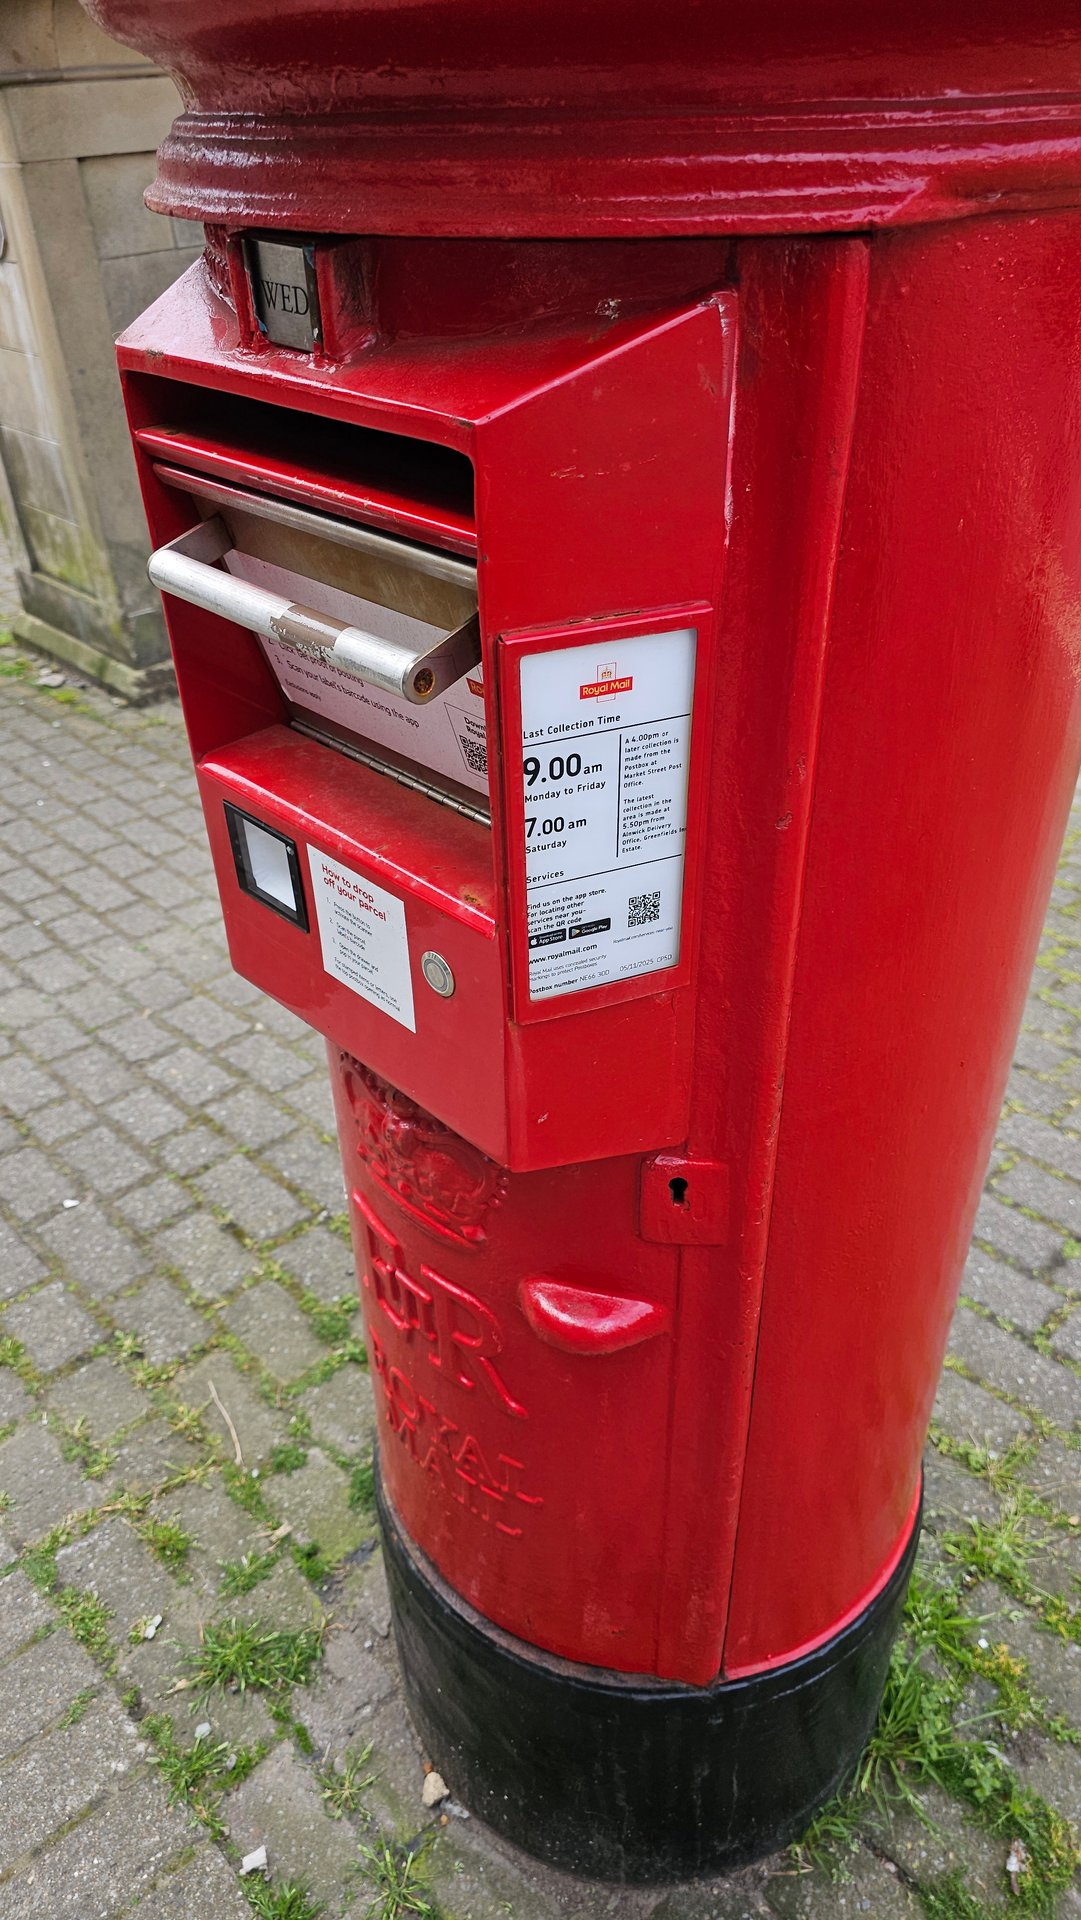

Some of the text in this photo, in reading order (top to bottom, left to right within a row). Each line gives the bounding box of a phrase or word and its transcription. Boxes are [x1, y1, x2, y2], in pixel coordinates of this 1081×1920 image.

[261, 280, 309, 316] WED
[286, 660, 304, 674] Scan
[304, 670, 319, 681] your
[340, 684, 370, 705] barcode
[370, 700, 392, 716] using
[391, 708, 404, 720] the
[405, 716, 420, 728] app
[582, 680, 630, 696] Royal Mail
[523, 715, 621, 740] Last Collection Time
[631, 732, 660, 742] 4.00pm
[624, 746, 640, 754] later
[642, 740, 672, 750] collection
[644, 750, 658, 758] from
[624, 762, 648, 771] Postbox
[624, 770, 646, 780] Market
[648, 766, 666, 774] Street
[624, 780, 644, 788] Office.
[524, 790, 560, 803] Monday
[578, 781, 606, 792] Friday
[636, 794, 654, 802] latest
[622, 803, 652, 814] collection
[622, 814, 636, 822] area
[646, 808, 662, 816] made
[524, 816, 587, 838] 7.00 am
[622, 820, 650, 830] 5.50pm
[622, 823, 672, 838] Alnwick Delivery
[644, 829, 678, 840] Greenfields
[525, 840, 567, 854] Saturday
[622, 846, 642, 854] Estate.
[322, 864, 374, 903] How to drop
[526, 870, 564, 884] Services
[324, 877, 386, 922] off your parcel
[526, 902, 540, 910] Find
[574, 892, 587, 900] app
[588, 888, 606, 896] store.
[540, 906, 565, 916] locating
[566, 902, 584, 910] other
[528, 916, 553, 926] services
[554, 912, 570, 920] near
[544, 922, 554, 930] the
[581, 926, 598, 934] Google
[550, 934, 564, 942] Store
[528, 944, 598, 965] www.royalmail.com
[557, 968, 574, 976] protect
[554, 978, 578, 988] number
[580, 974, 596, 982] NE66
